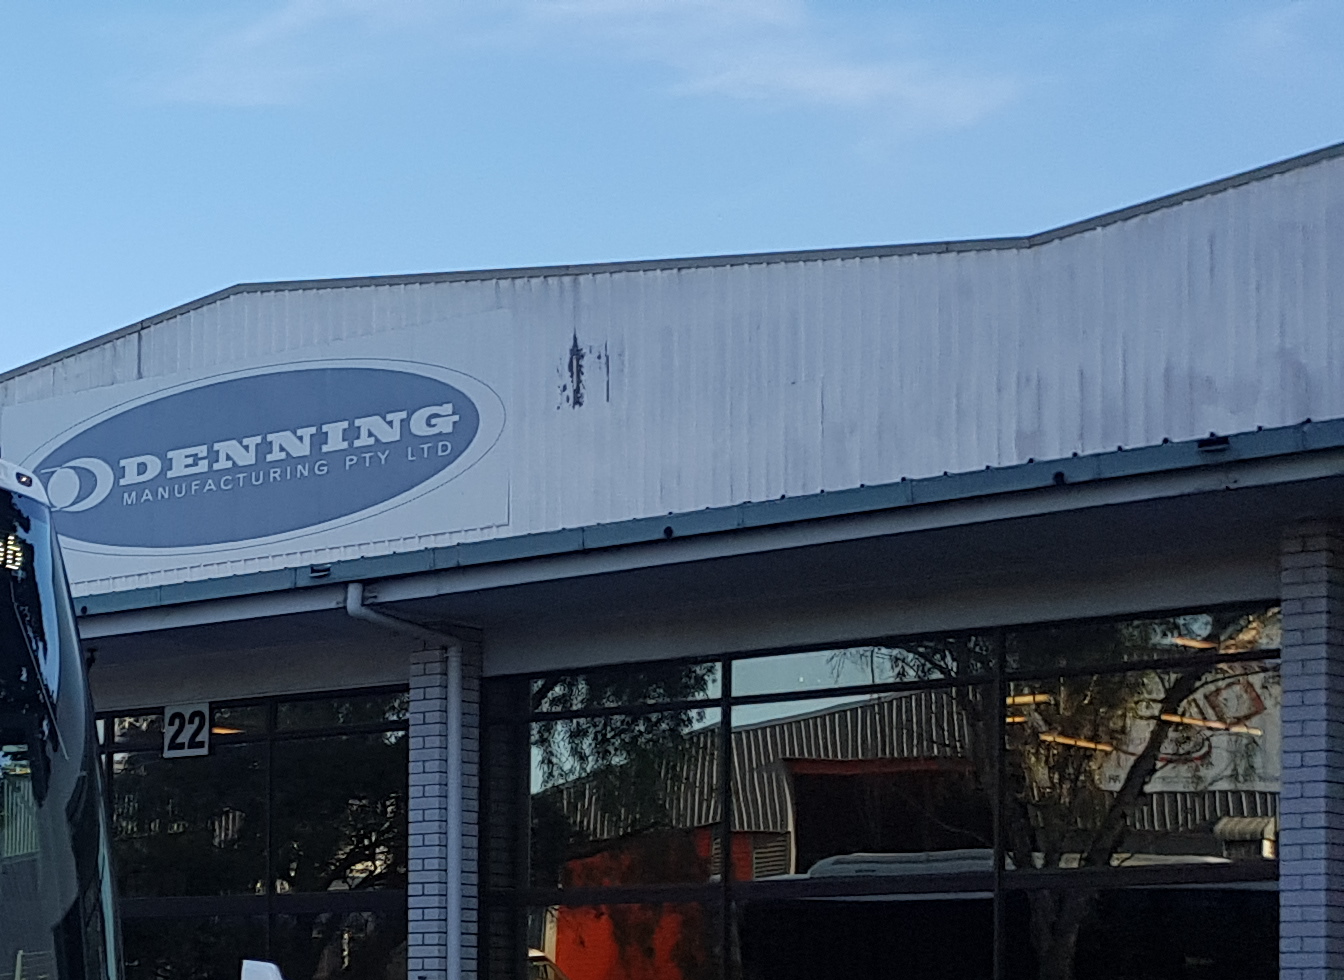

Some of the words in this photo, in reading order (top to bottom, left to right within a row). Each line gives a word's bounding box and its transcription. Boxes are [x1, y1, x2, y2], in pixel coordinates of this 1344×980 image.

[119, 402, 460, 486] DENNING
[123, 460, 328, 506] MANUFACTURING
[345, 450, 389, 471] PTY
[407, 441, 452, 461] LTD
[167, 710, 206, 751] 22
